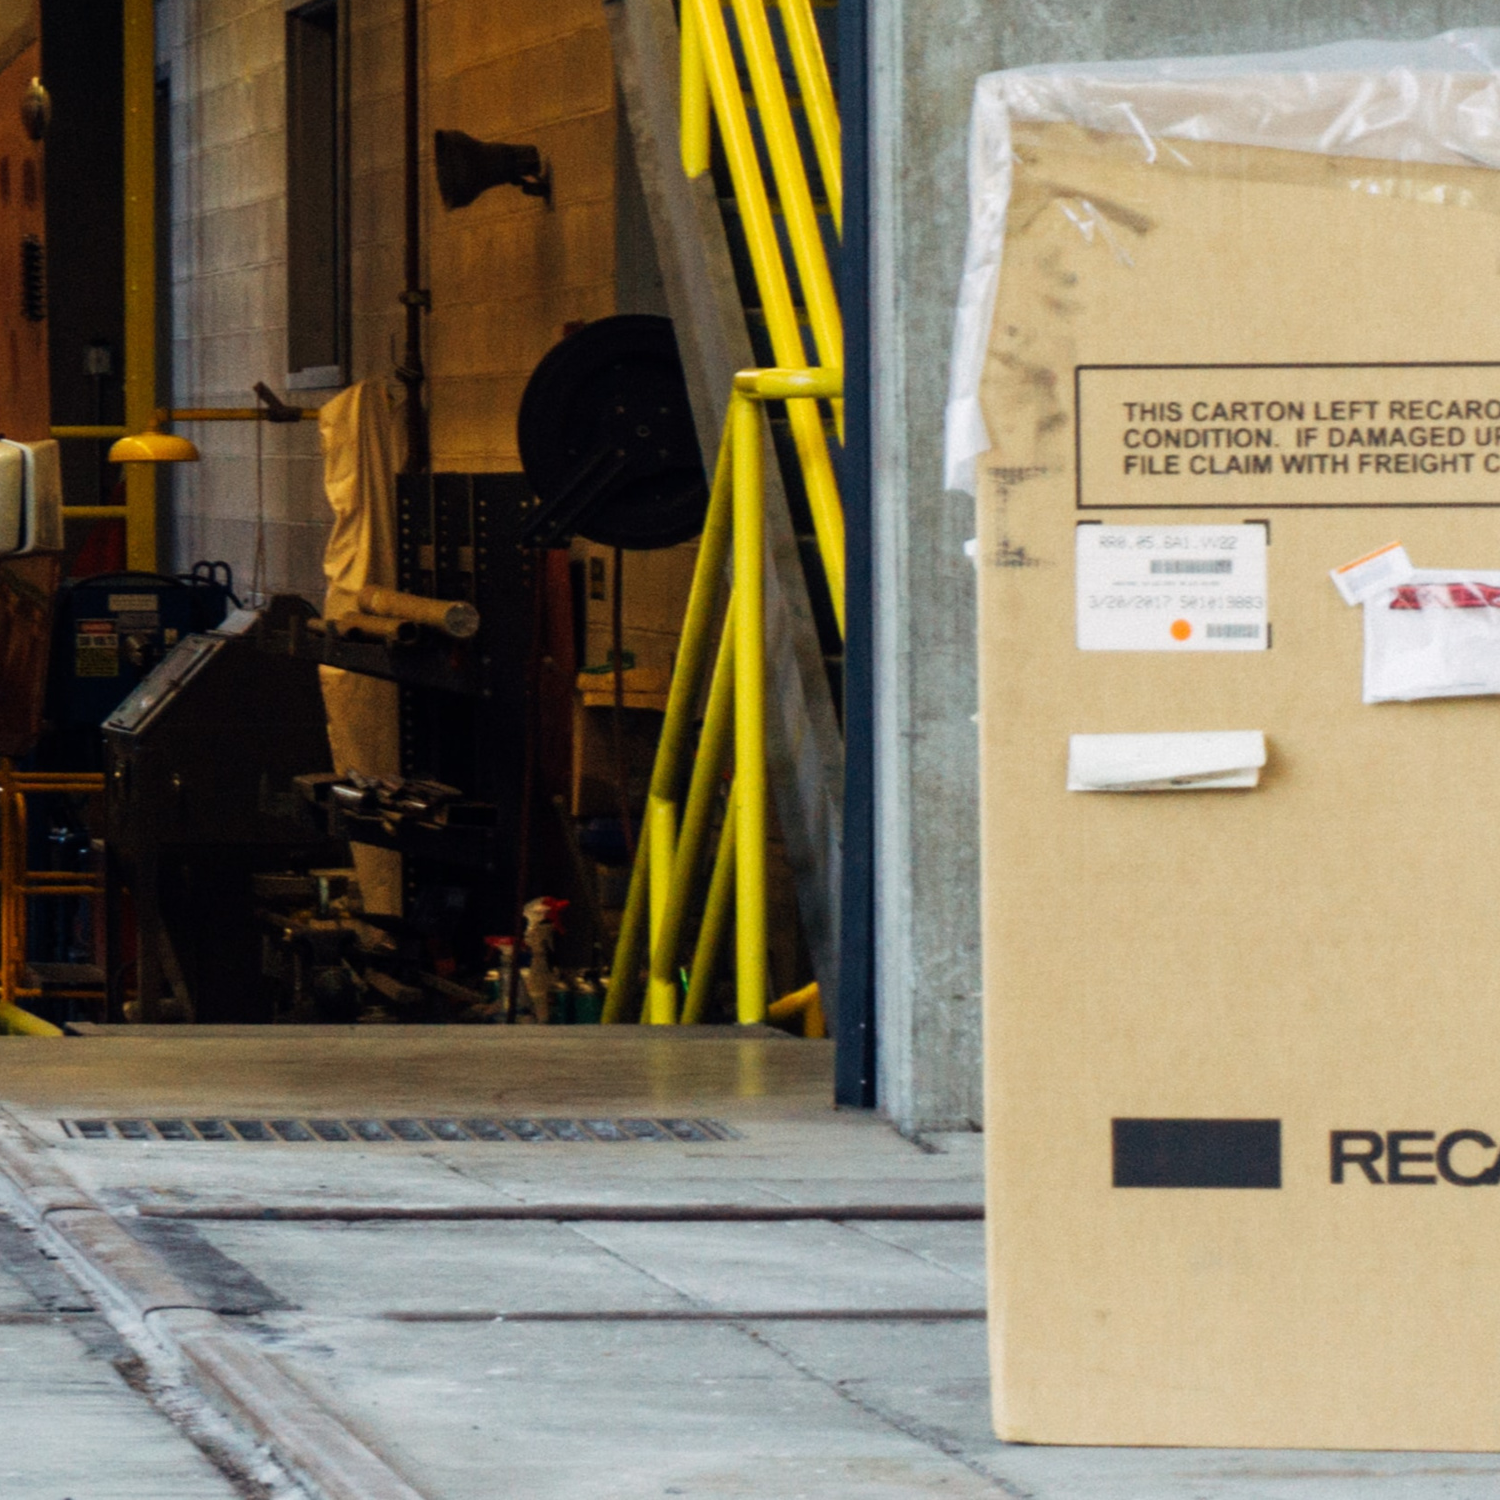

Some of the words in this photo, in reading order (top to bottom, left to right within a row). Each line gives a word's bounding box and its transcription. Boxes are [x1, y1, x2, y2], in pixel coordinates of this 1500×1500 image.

[1123, 402, 1183, 422] THIS
[1192, 401, 1305, 422] CARTON
[1315, 401, 1380, 421] LEFT
[1389, 399, 1500, 421] RECARO
[1123, 427, 1280, 449] CONDITION.
[1296, 427, 1318, 448] IF
[1328, 426, 1465, 448] DAMAGED
[1123, 455, 1181, 476] FILE
[1190, 454, 1273, 476] CLAIM
[1281, 453, 1349, 475] WITH
[1358, 452, 1475, 474] FREIGHT
[1329, 1128, 1500, 1187] REC
